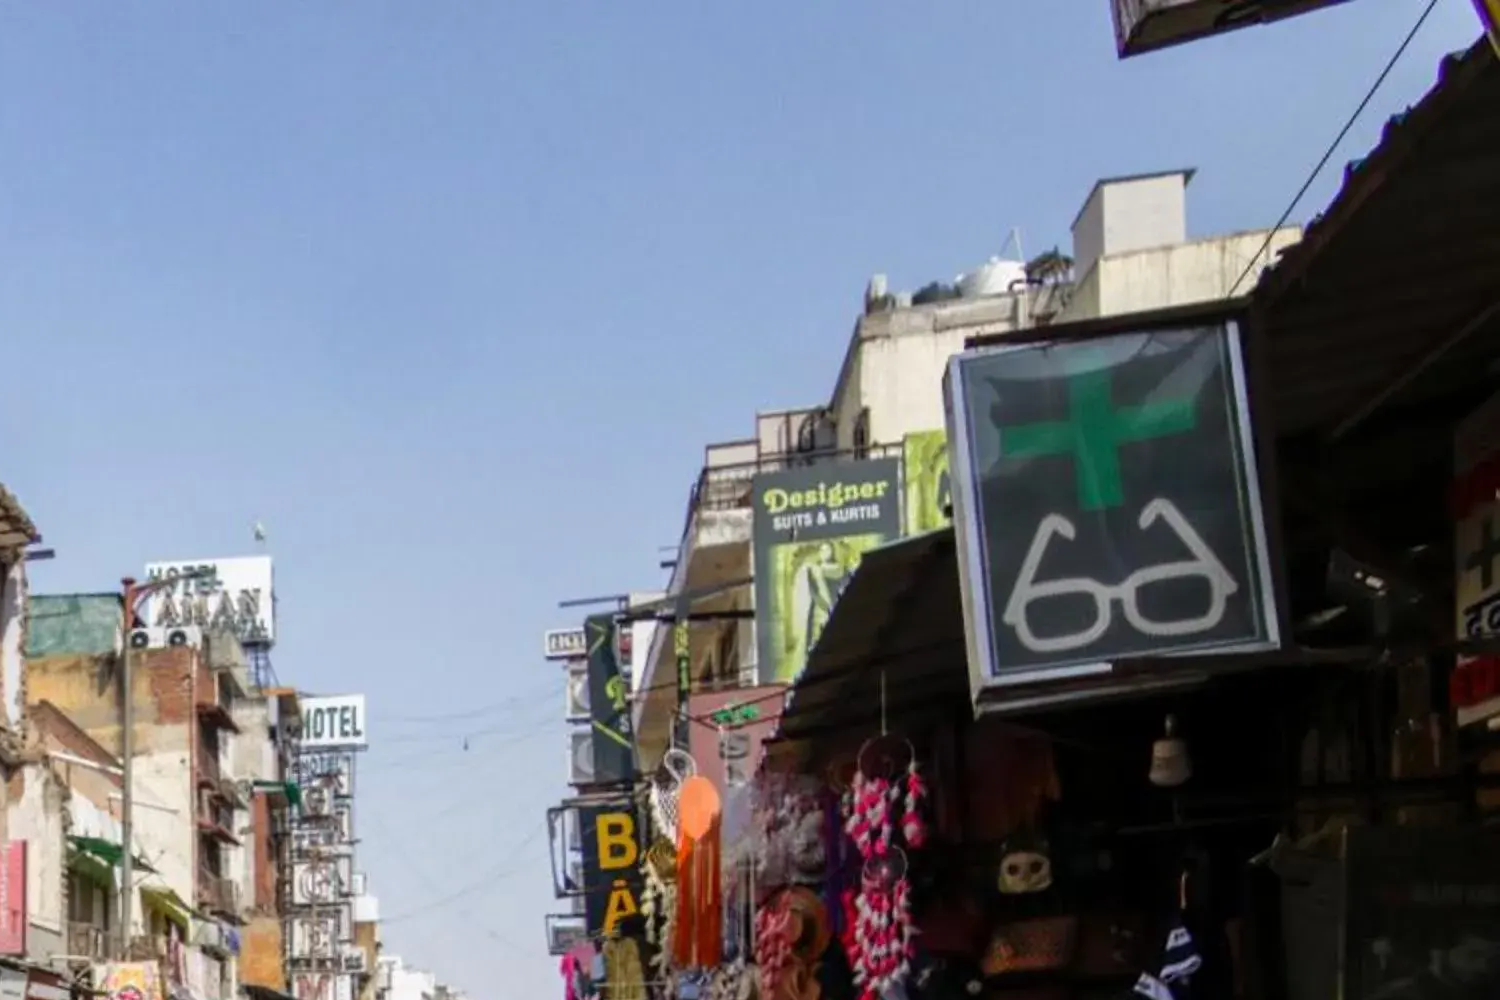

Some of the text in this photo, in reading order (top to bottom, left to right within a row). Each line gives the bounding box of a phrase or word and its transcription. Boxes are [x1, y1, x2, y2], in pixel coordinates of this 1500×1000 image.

[763, 480, 889, 513] Designer
[773, 504, 880, 530] SUITS & KURTIS
[301, 705, 363, 740] HOTEL
